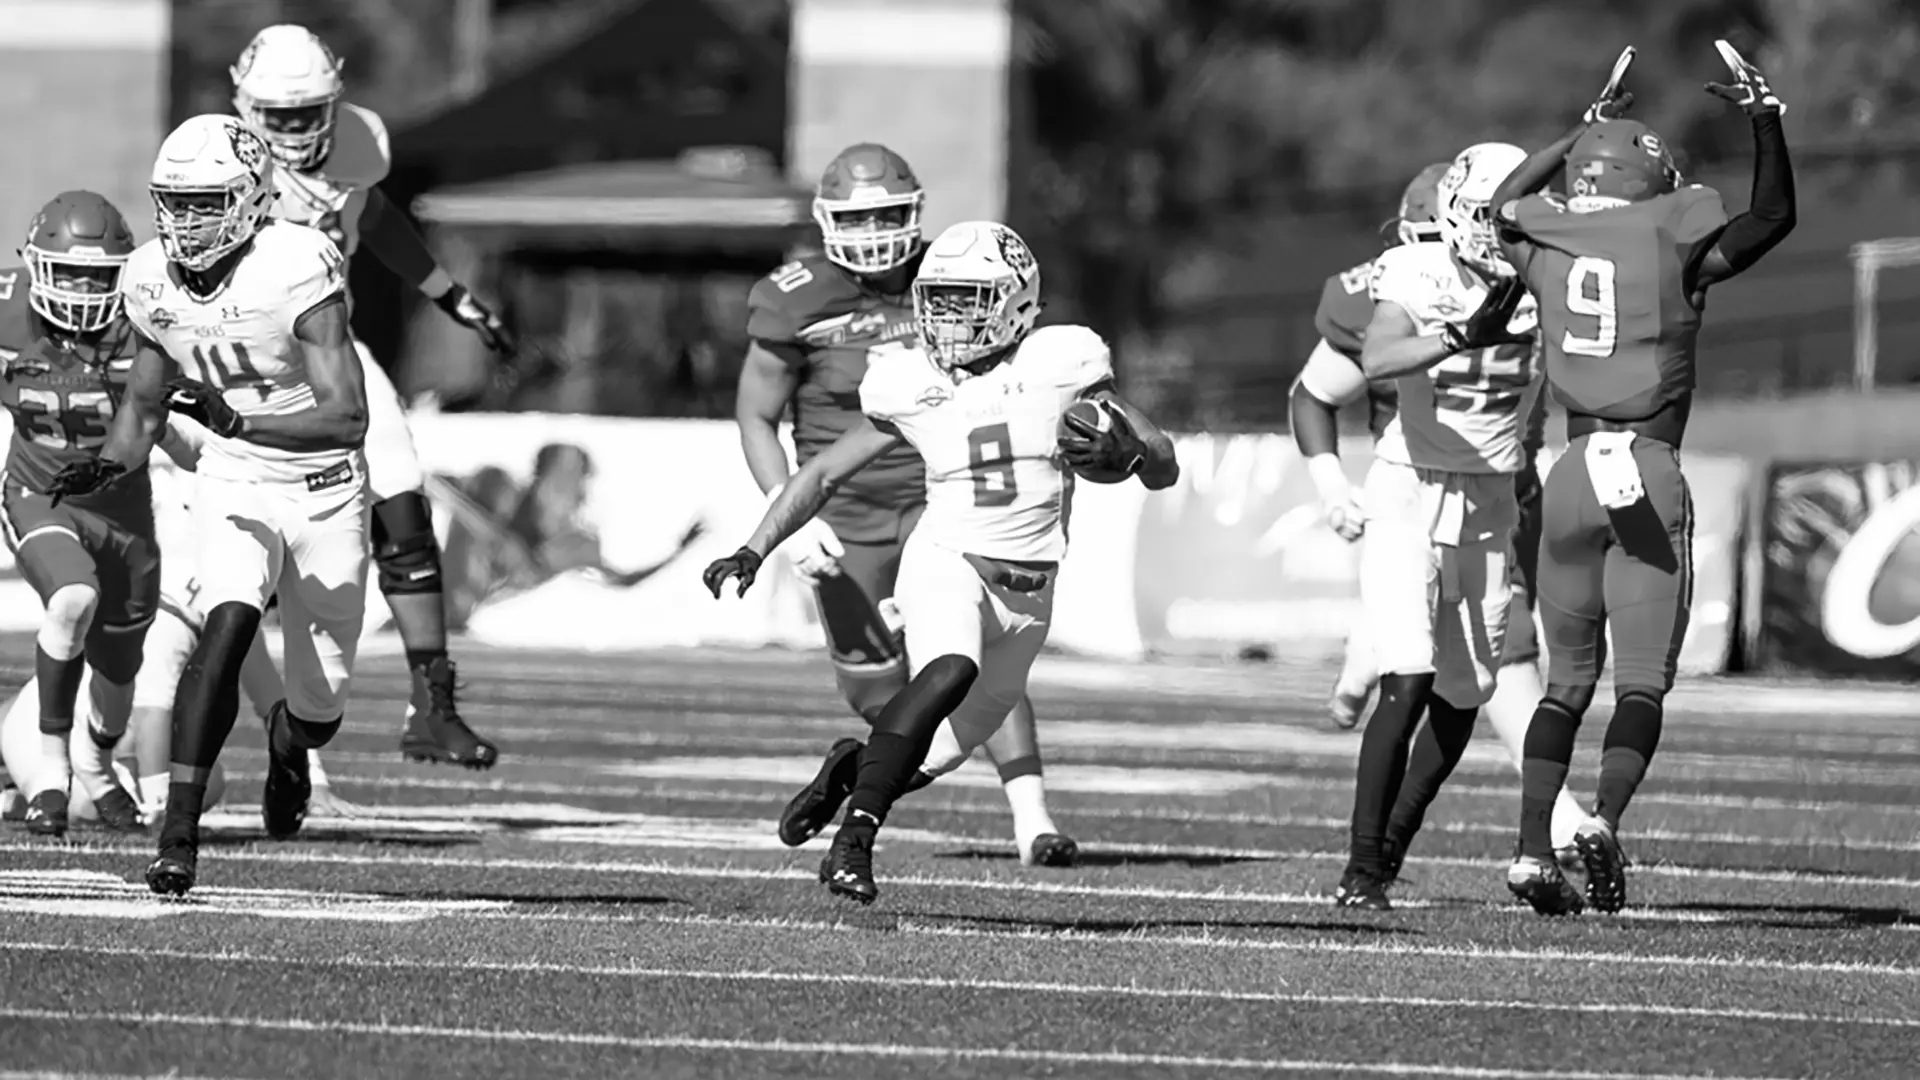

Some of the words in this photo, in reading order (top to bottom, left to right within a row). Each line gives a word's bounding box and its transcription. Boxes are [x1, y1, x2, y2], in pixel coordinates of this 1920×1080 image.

[1562, 256, 1616, 357] 9
[193, 341, 272, 402] 14
[19, 388, 114, 449] 33
[968, 422, 1018, 507] 8
